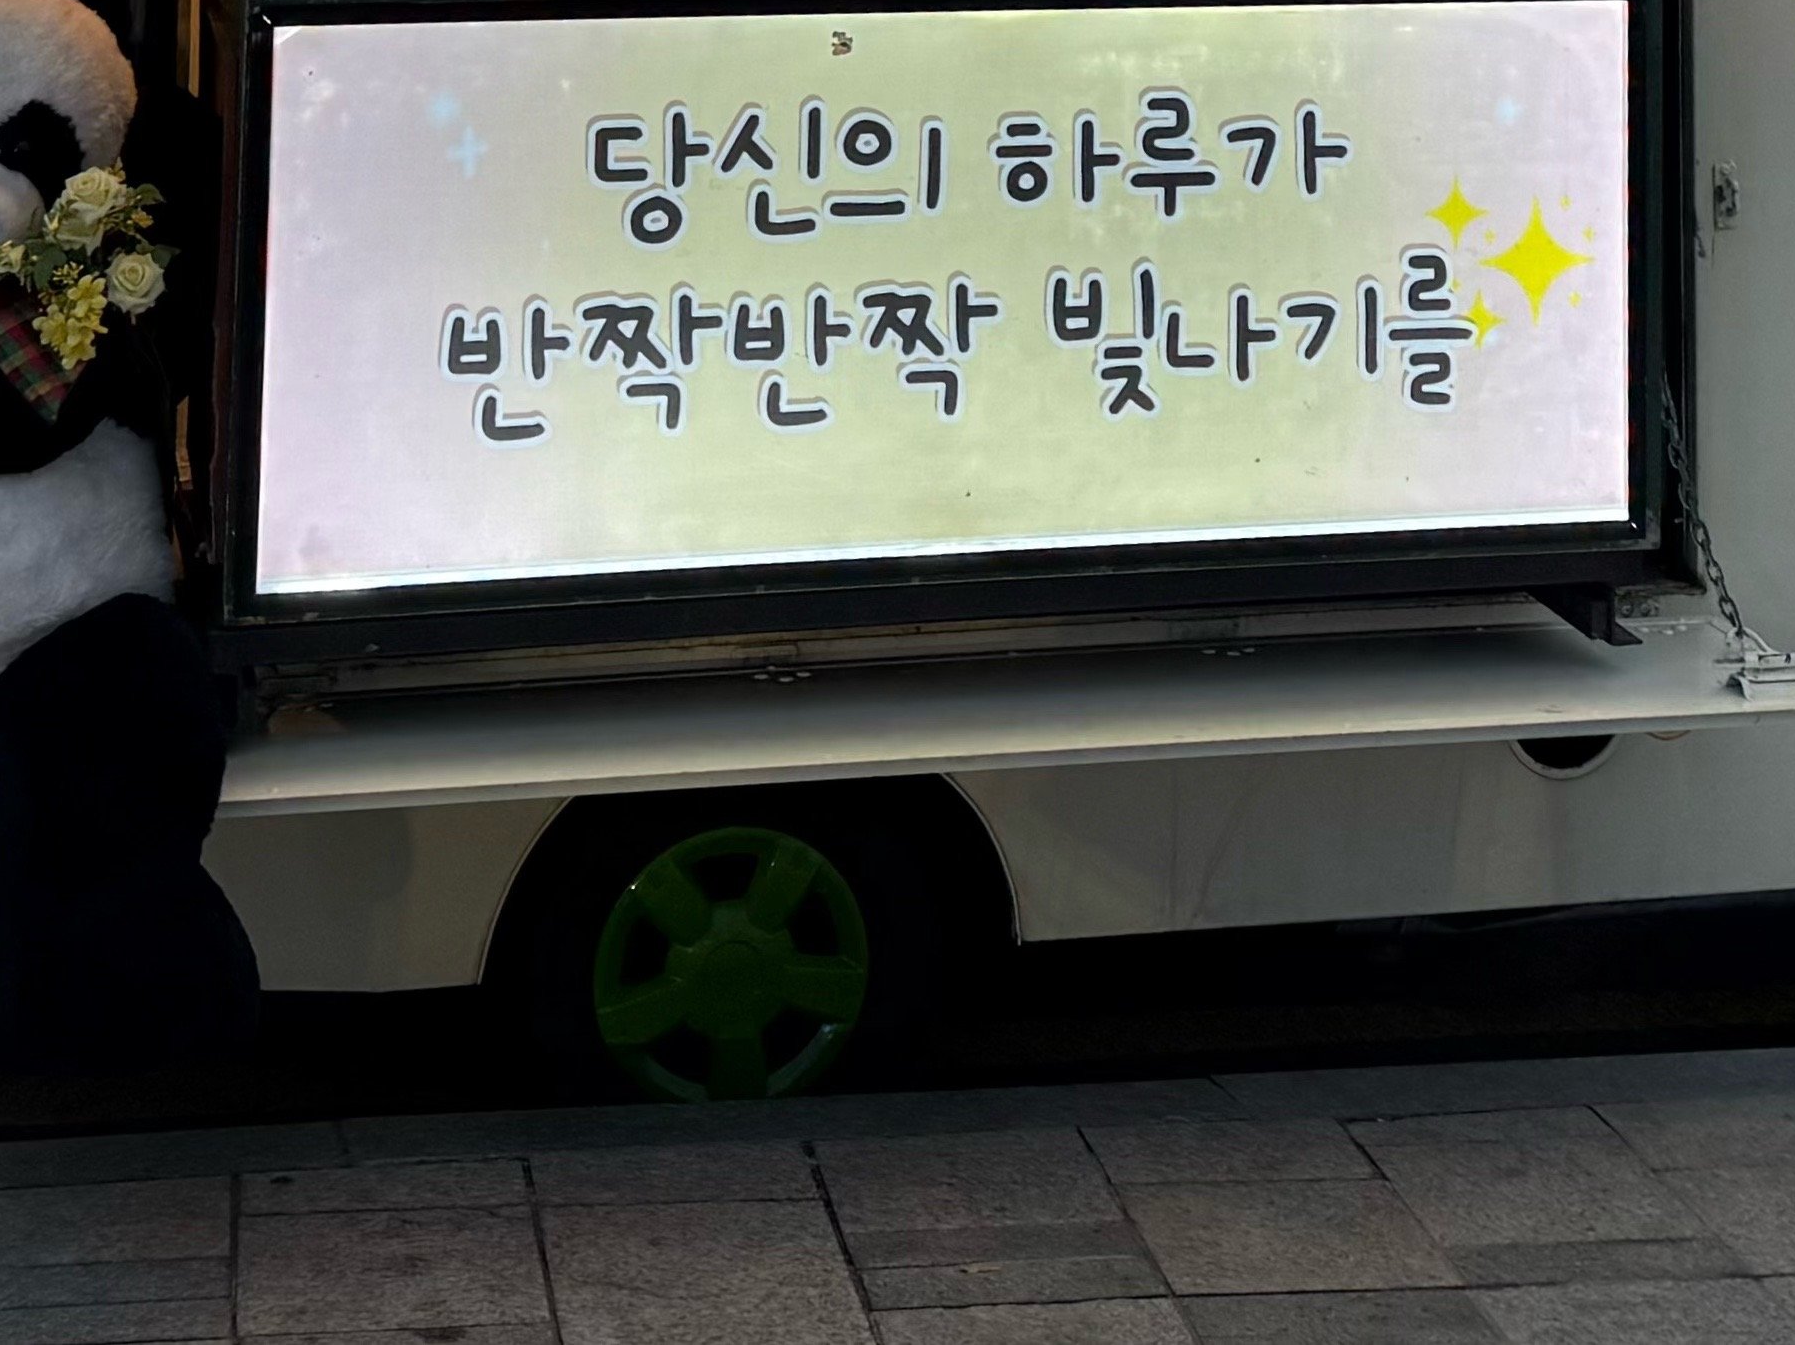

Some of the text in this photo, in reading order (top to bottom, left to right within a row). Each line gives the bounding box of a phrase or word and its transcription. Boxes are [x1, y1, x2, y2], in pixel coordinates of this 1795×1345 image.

[589, 90, 1351, 245] 당신의 하루가
[441, 244, 1478, 441] 반짝반짝 빛나기를
